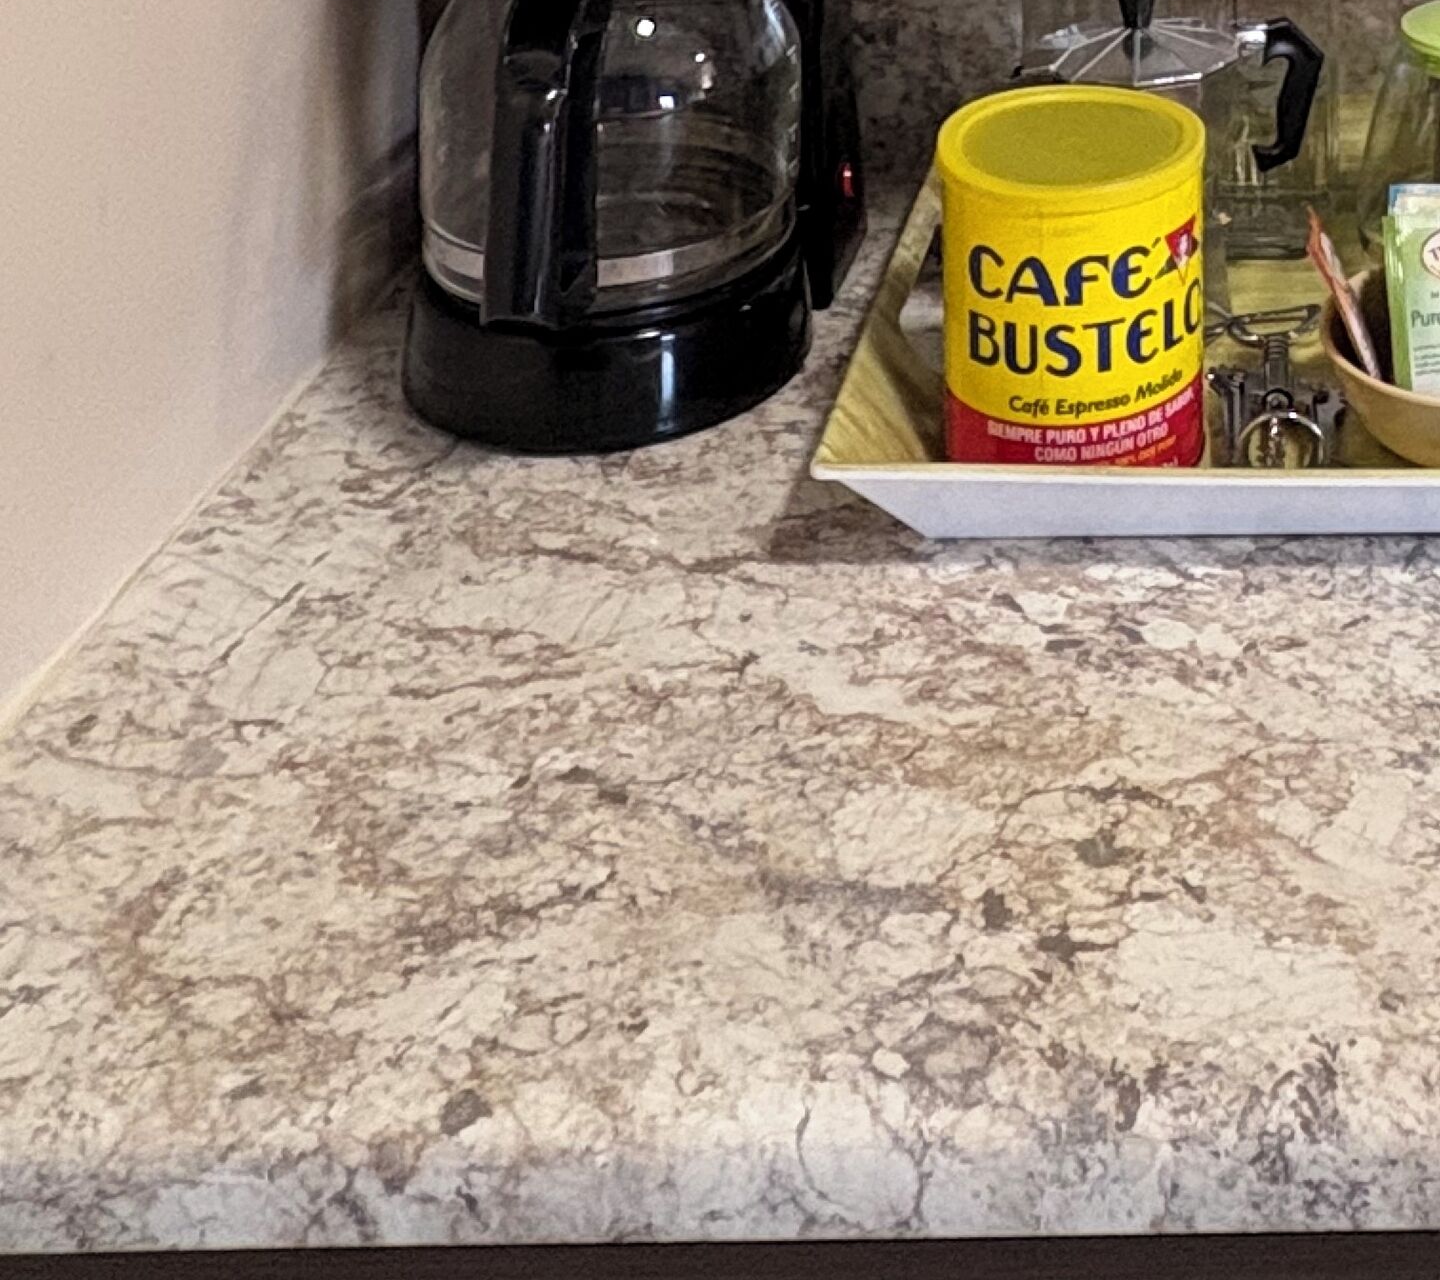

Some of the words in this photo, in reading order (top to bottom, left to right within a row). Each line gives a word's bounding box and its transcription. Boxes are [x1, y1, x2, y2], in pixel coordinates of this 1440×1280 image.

[968, 277, 1201, 377] BUSTELO
[987, 420, 1044, 444] SIEMPRE
[1046, 428, 1086, 445] PURO
[1088, 426, 1099, 442] Y
[1103, 415, 1147, 440] PLENO
[1147, 405, 1164, 427] DE
[1008, 395, 1050, 418] Café
[1055, 393, 1131, 419] Espresso
[1034, 445, 1078, 462] COMO
[1136, 421, 1169, 448] OTRO
